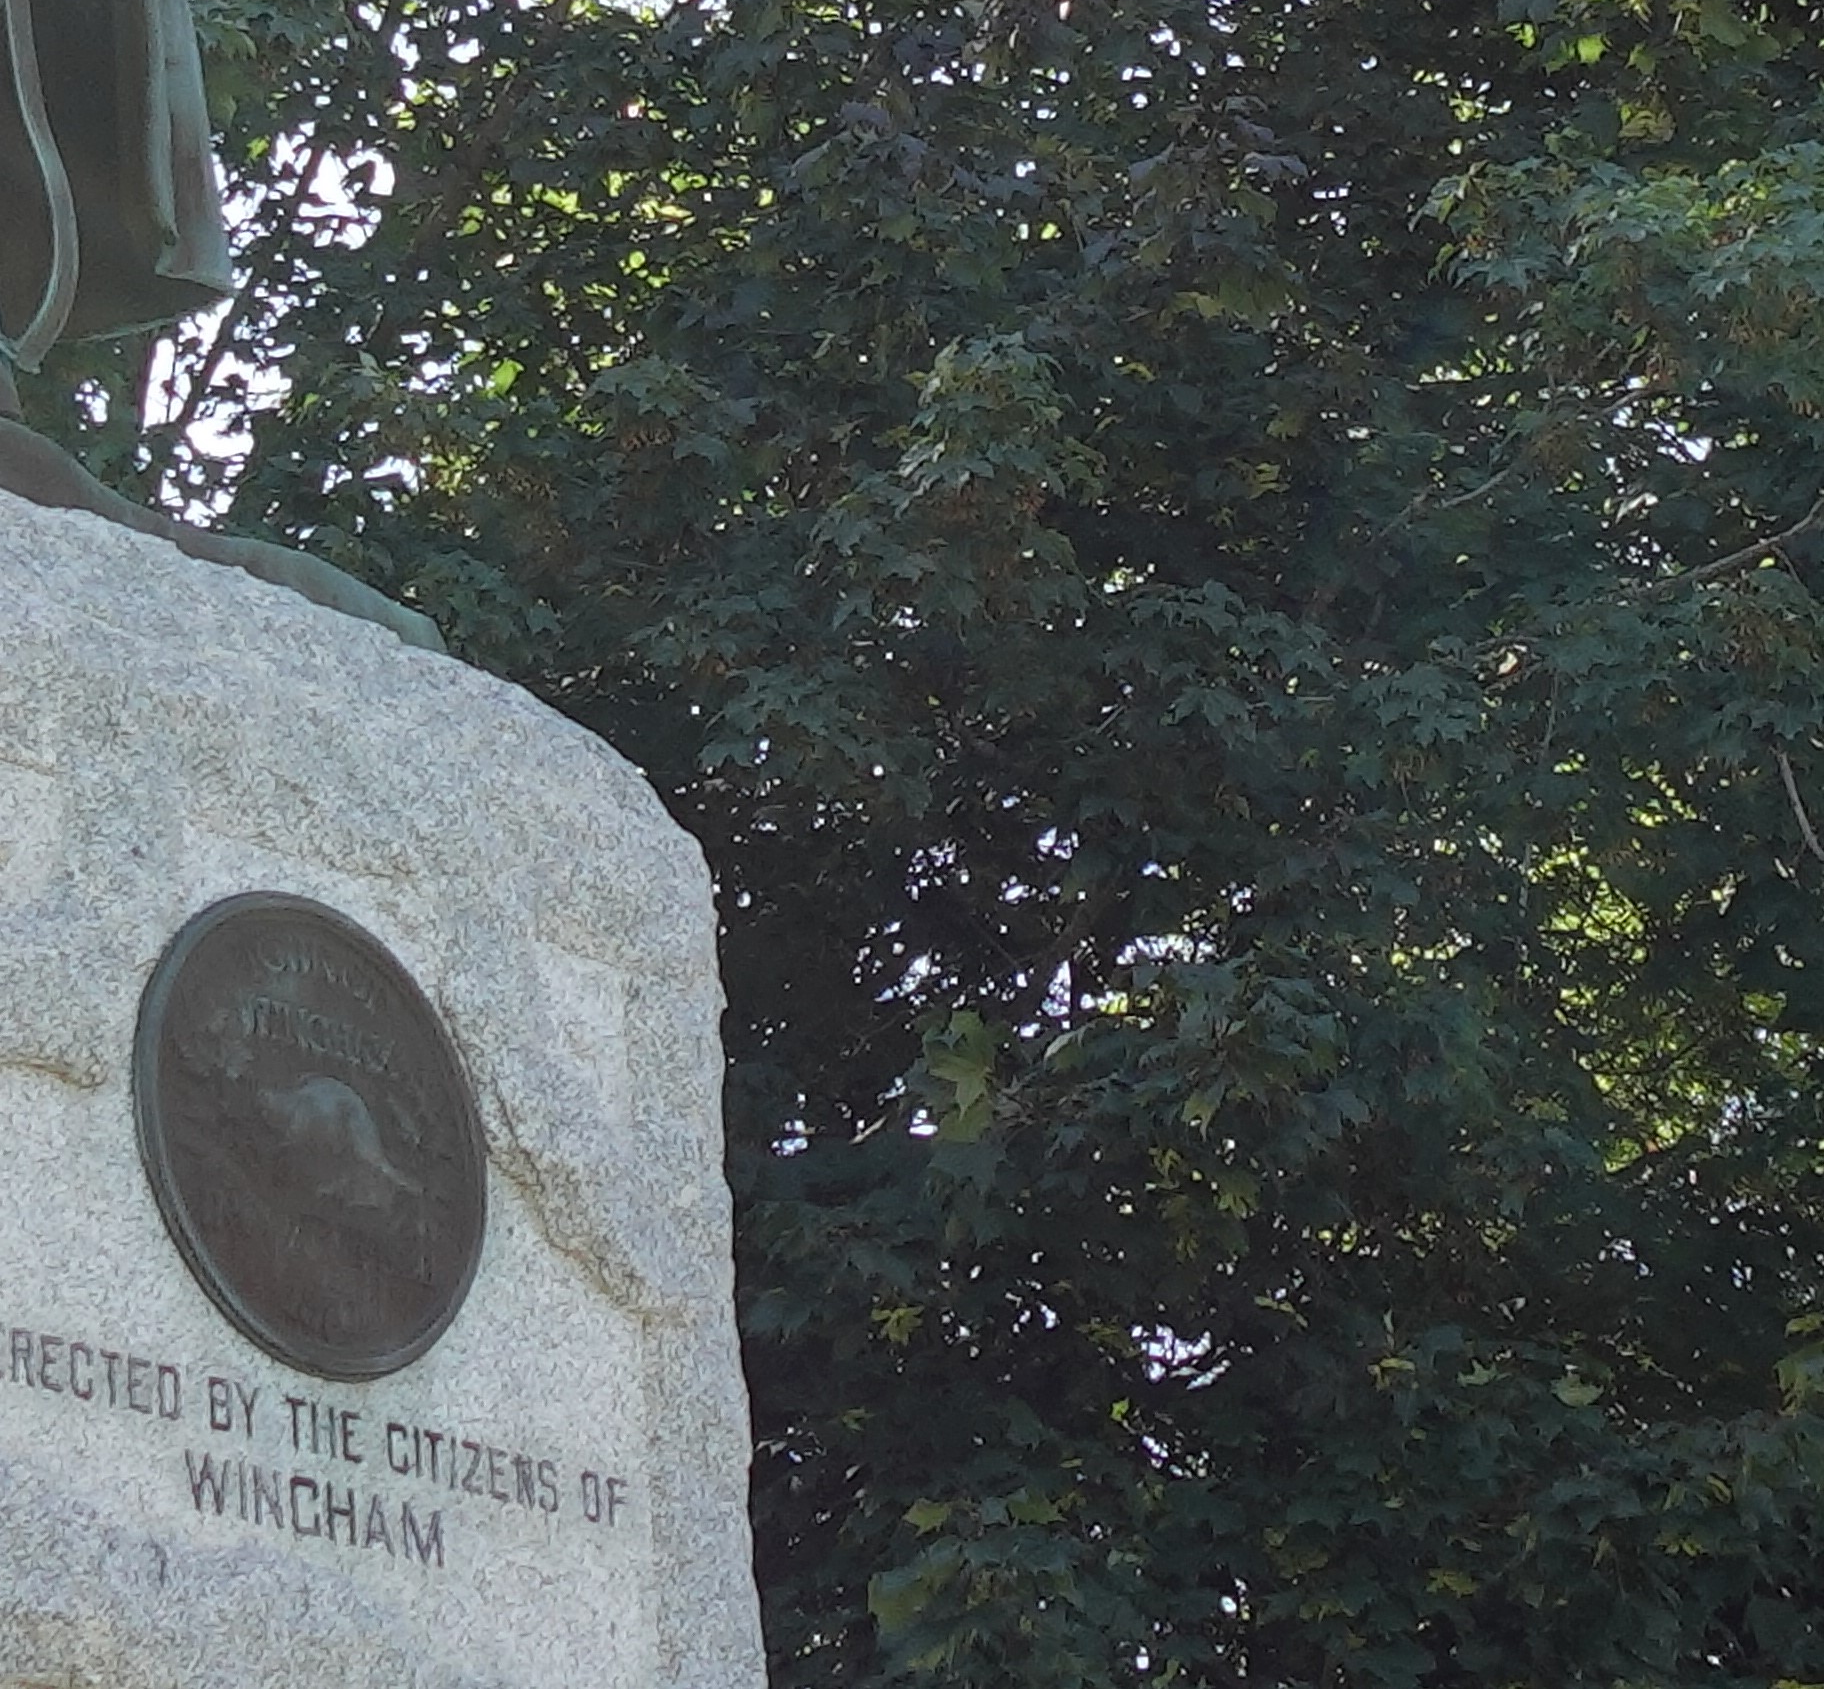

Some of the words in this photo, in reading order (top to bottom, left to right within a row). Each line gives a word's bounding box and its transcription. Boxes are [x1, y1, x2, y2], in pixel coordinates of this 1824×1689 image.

[207, 1376, 256, 1436] BY
[285, 1396, 362, 1464] THE
[386, 1422, 559, 1513] CITIZENS
[581, 1470, 628, 1525] OF
